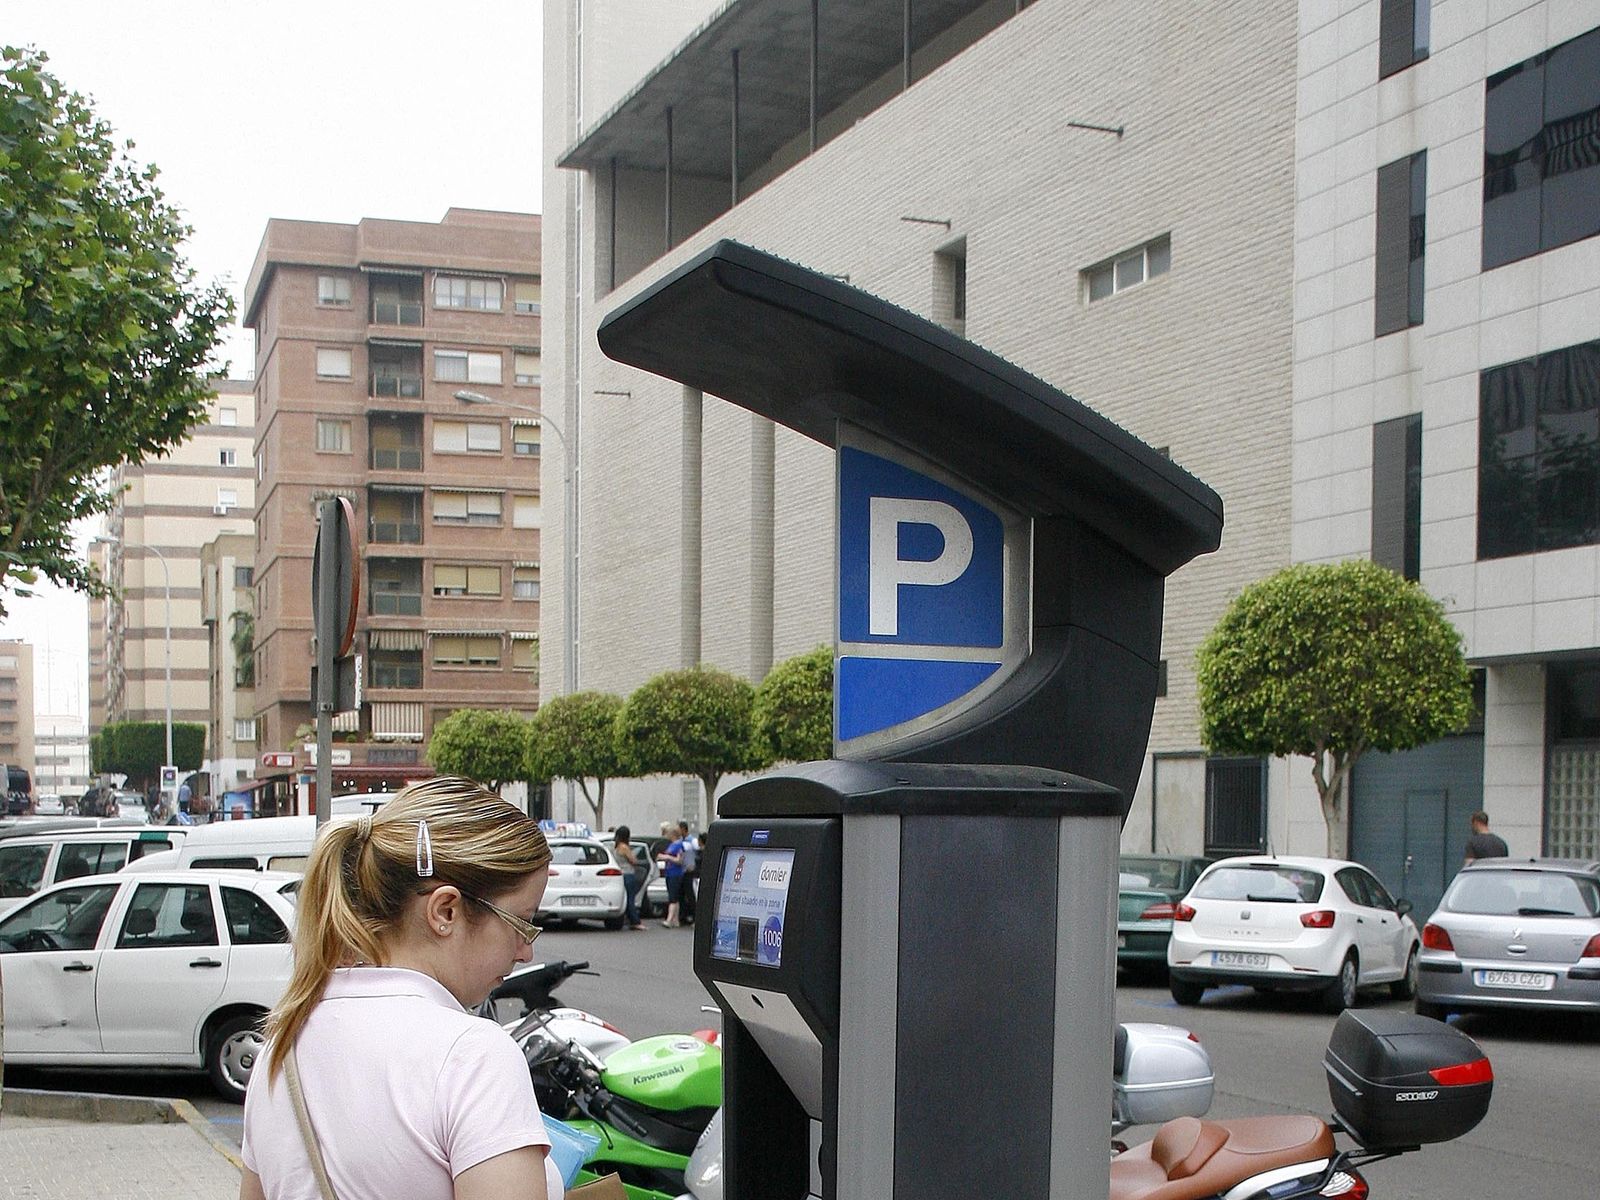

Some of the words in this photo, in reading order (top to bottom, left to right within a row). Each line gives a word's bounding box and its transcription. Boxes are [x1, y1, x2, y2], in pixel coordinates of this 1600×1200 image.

[869, 496, 973, 635] P
[761, 866, 787, 881] dornier
[764, 930, 782, 947] 1006
[633, 1065, 685, 1085] Kawasaki
